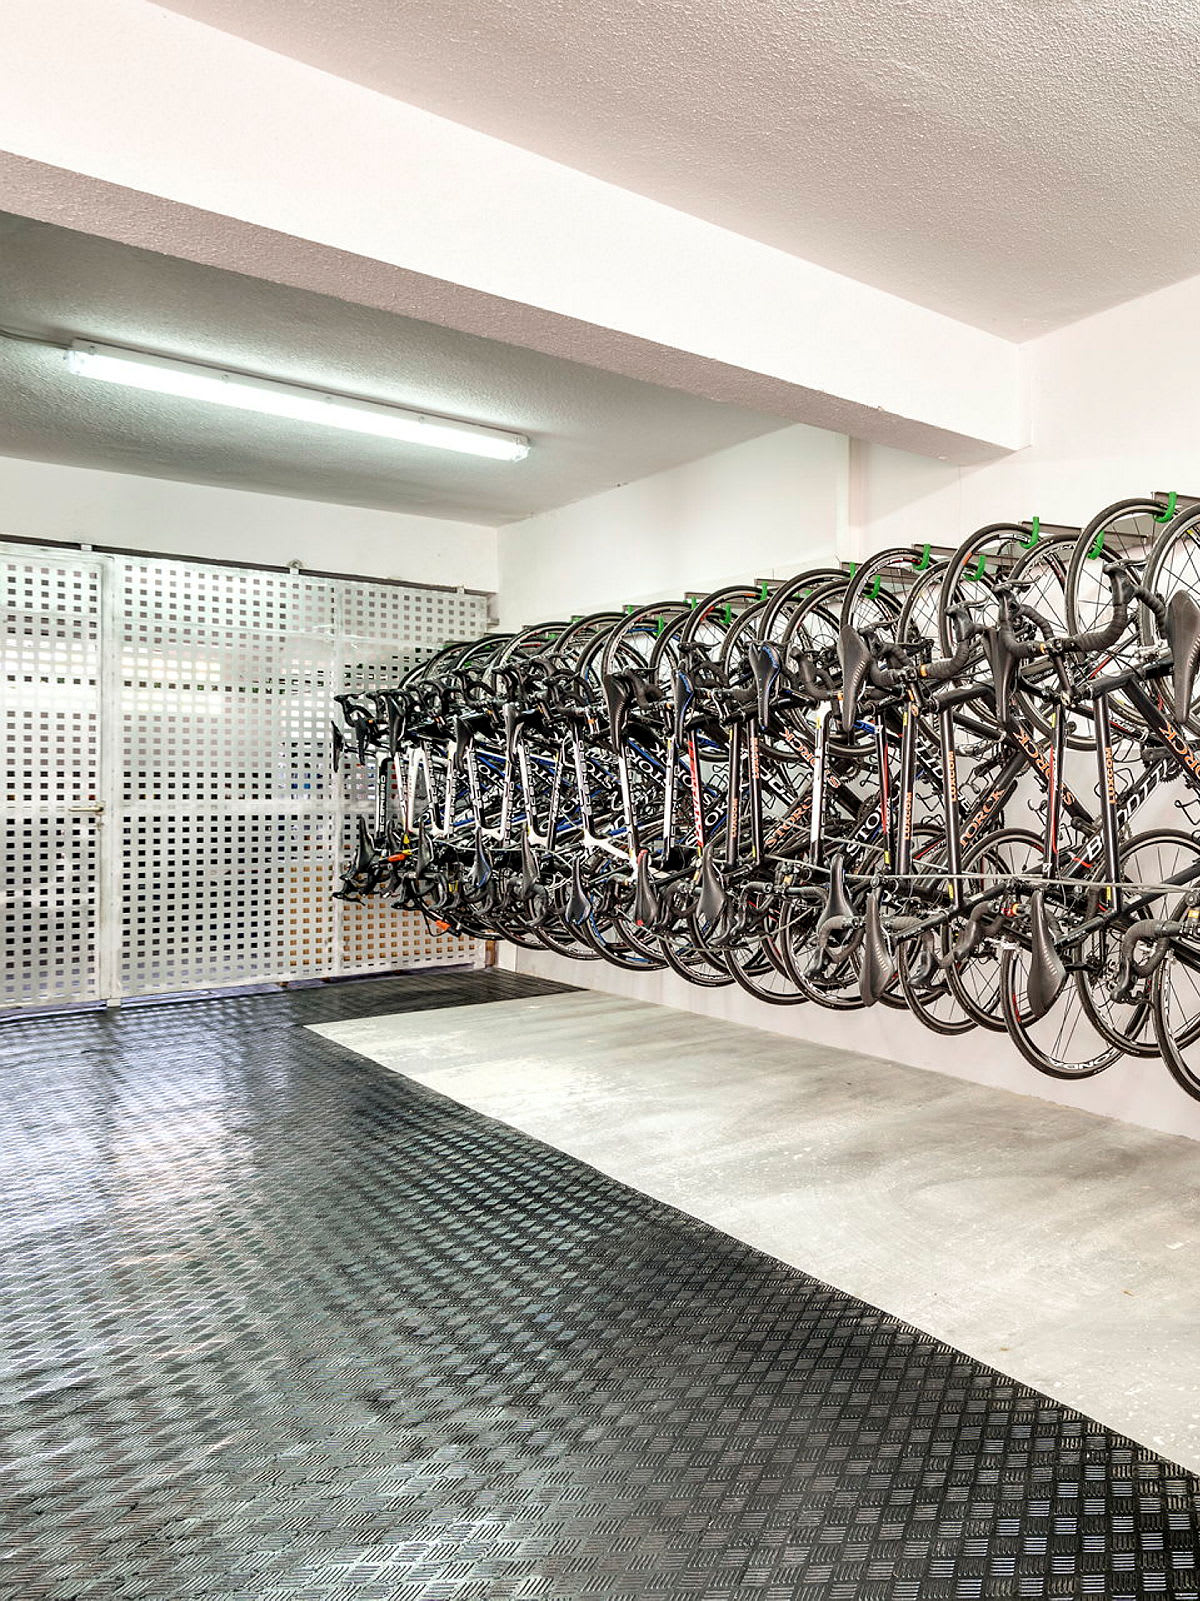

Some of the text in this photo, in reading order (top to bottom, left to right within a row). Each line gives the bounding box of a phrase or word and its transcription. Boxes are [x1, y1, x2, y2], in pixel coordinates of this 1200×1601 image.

[949, 750, 957, 802] LUXCOM
[1105, 747, 1117, 804] LUXCOM
[764, 796, 813, 846] STORC
[904, 792, 912, 840] LUXCOM
[960, 788, 1005, 848] TORCK
